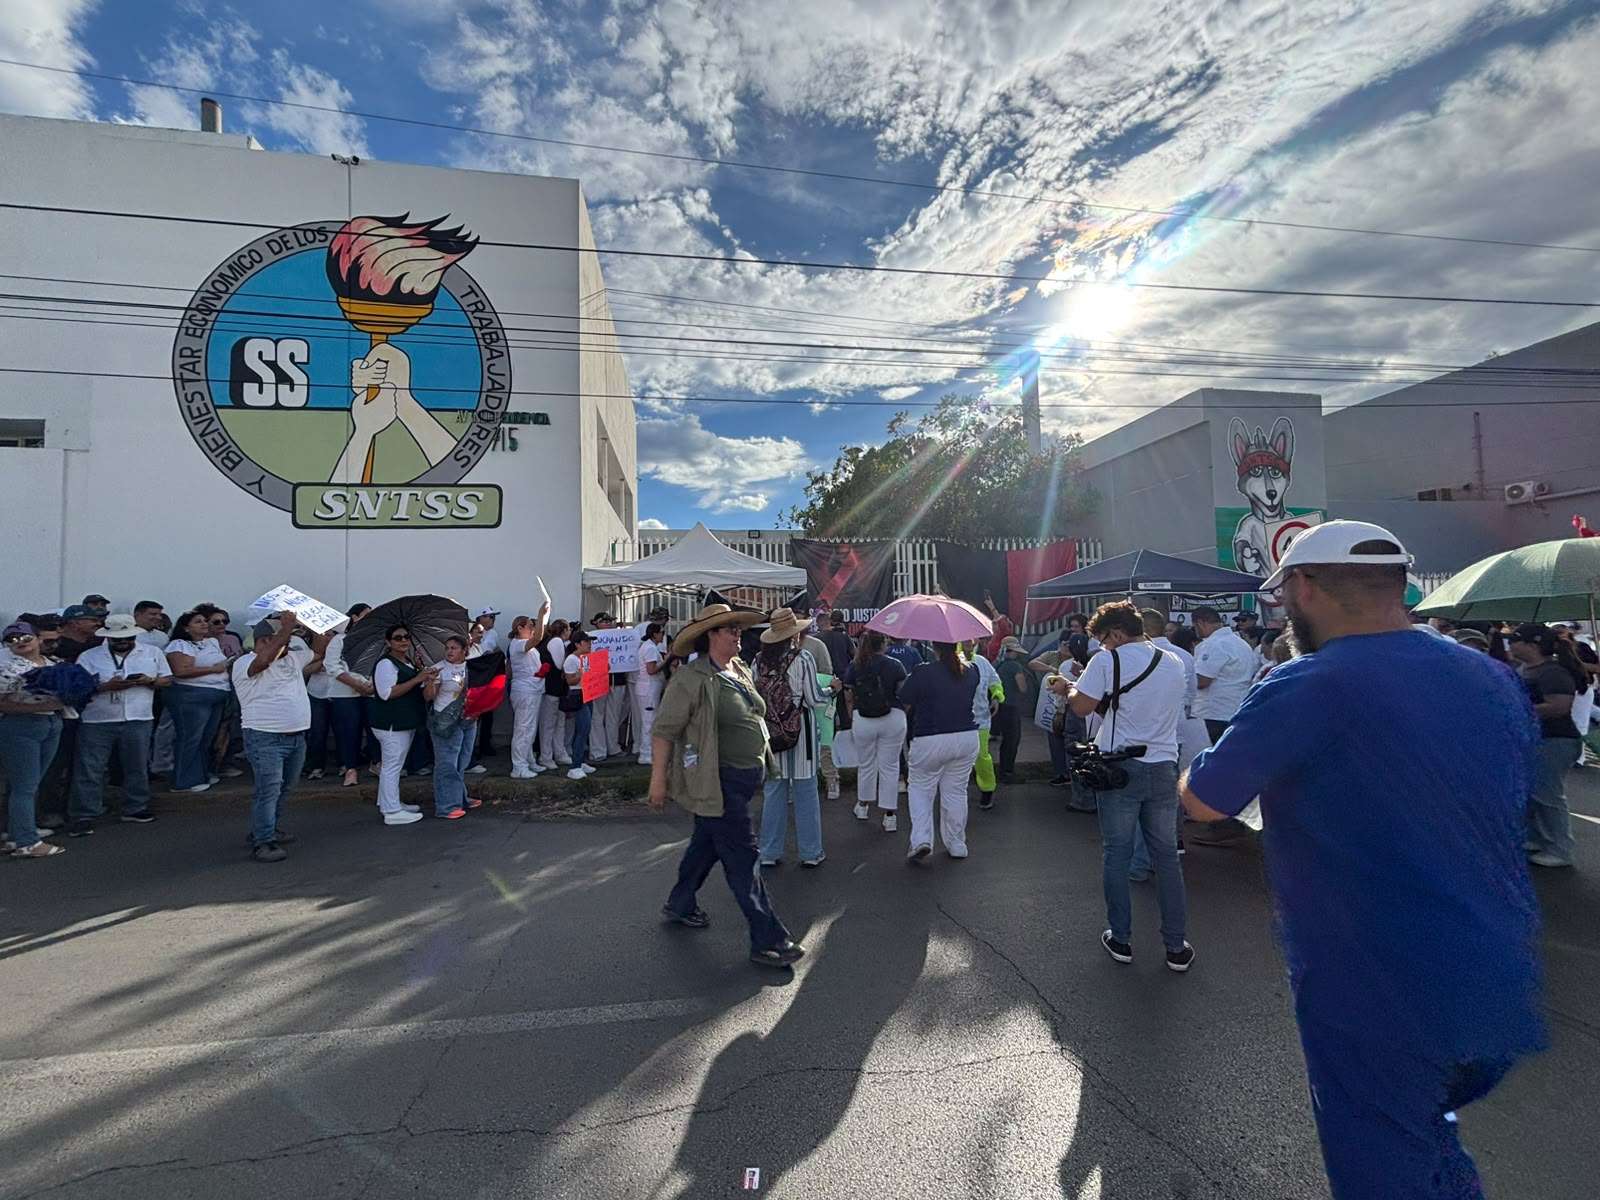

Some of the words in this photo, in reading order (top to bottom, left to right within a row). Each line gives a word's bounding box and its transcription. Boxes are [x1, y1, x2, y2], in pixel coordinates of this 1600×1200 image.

[268, 233, 293, 255] DE
[292, 225, 329, 248] LOS
[185, 248, 264, 339] ECONOMICO
[232, 336, 310, 408] SS
[451, 284, 506, 469] TRABAJADORES
[182, 344, 243, 473] BIENESTAR
[246, 475, 265, 495] Y
[313, 487, 485, 521] SNTSS
